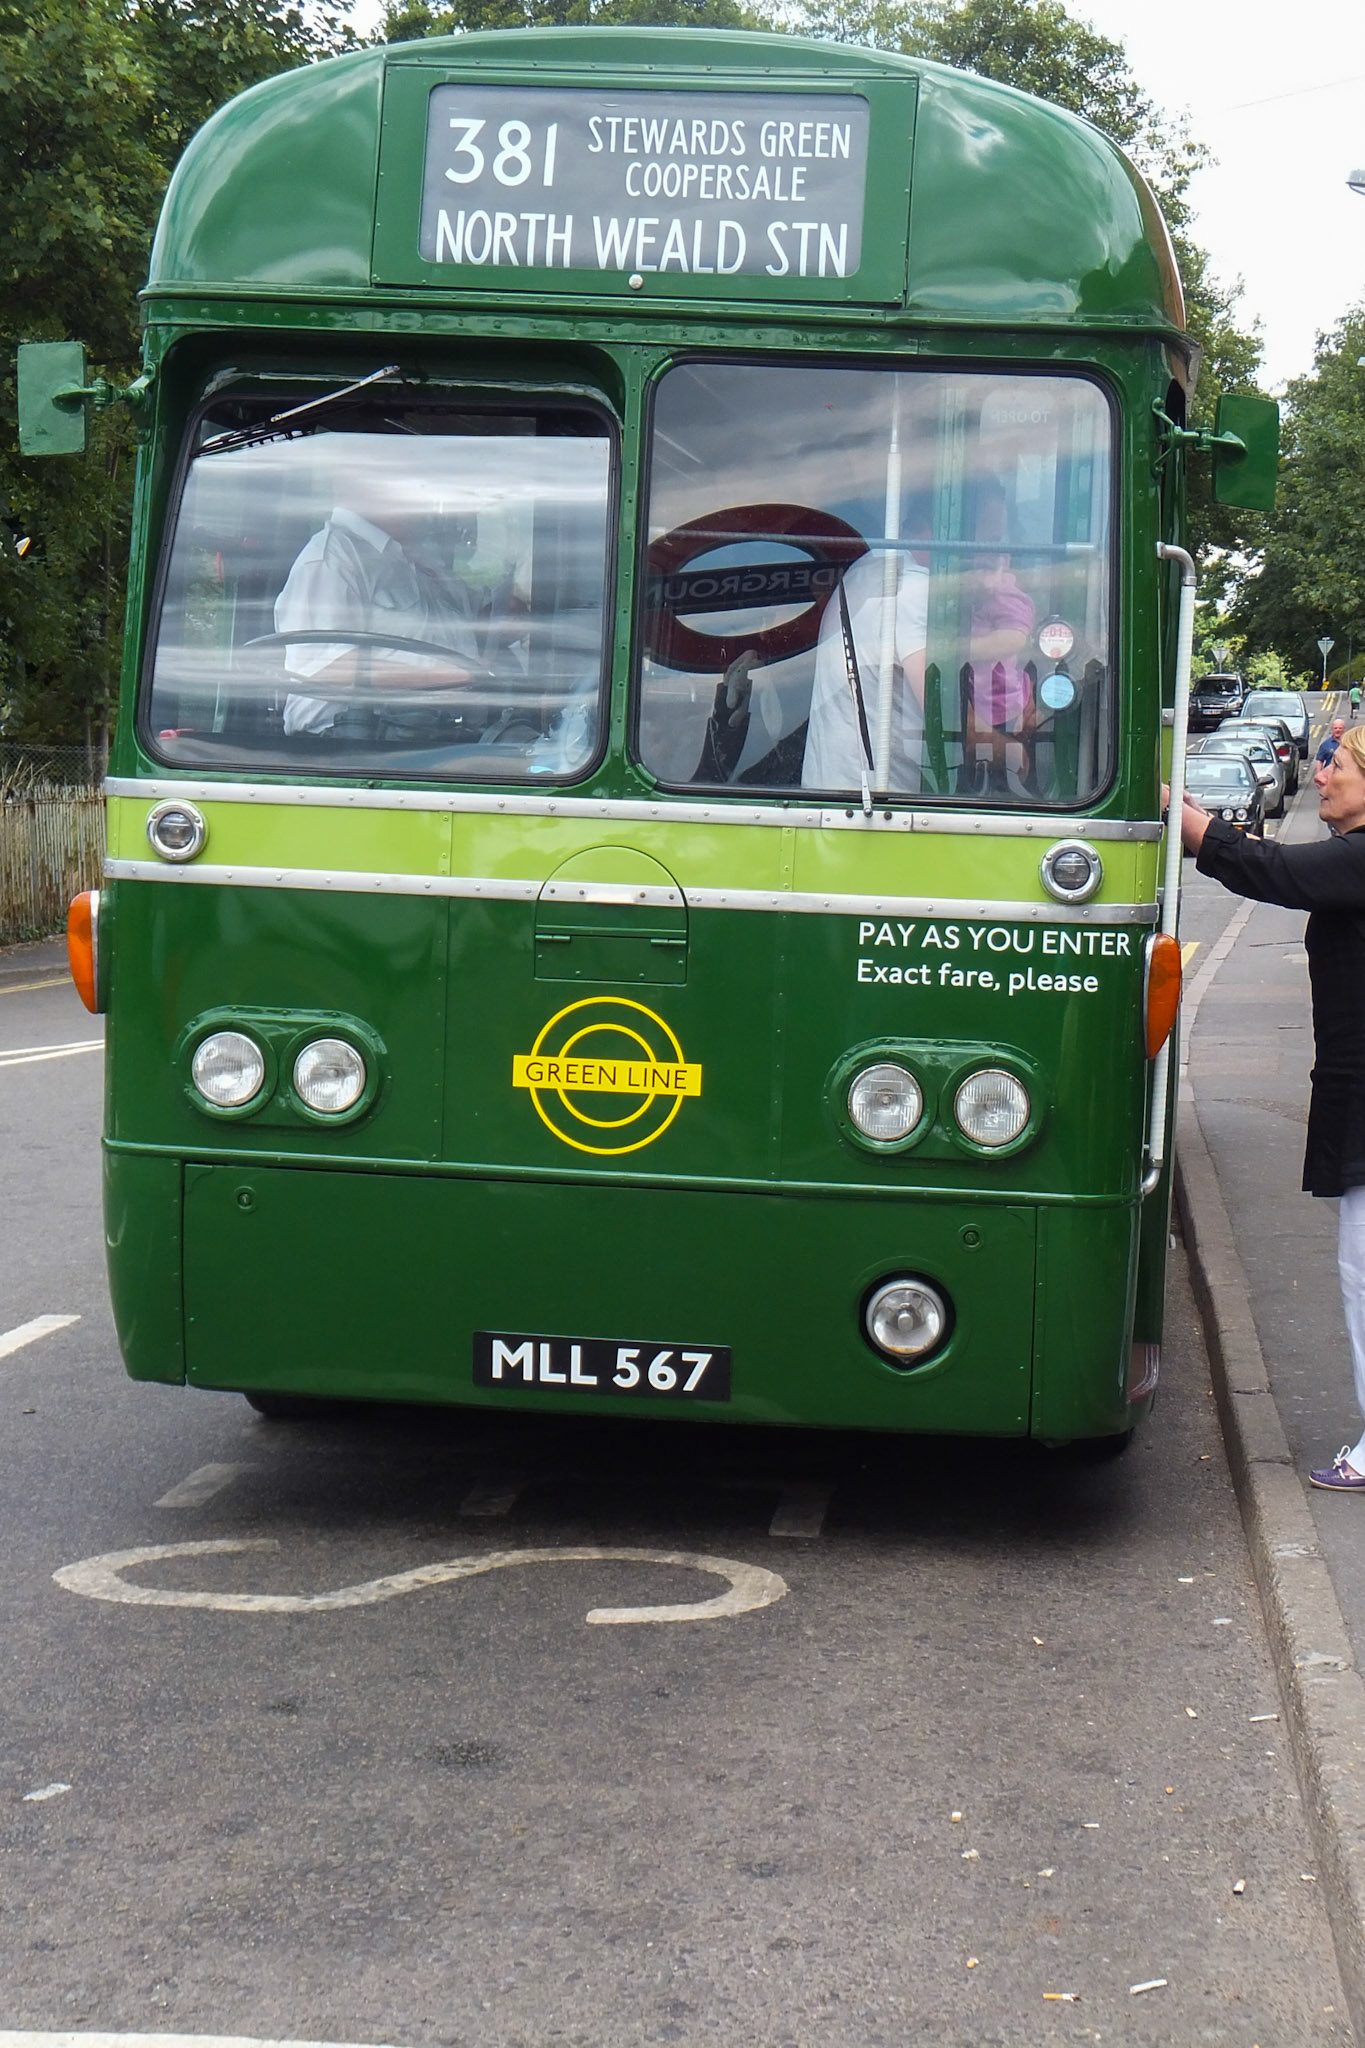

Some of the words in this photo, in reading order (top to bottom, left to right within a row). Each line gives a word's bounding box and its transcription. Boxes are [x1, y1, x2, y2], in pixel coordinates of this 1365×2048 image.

[445, 118, 557, 187] 381
[587, 116, 746, 155] STEWARDS
[759, 122, 850, 159] GREEN
[625, 163, 807, 201] COOPERSALE
[436, 209, 572, 267] NORTH
[592, 215, 746, 274] WEALD
[765, 222, 848, 278] STN
[858, 921, 916, 947] PAY
[920, 924, 960, 949] AS
[967, 927, 1035, 953] YOU
[1041, 930, 1131, 956] ENTER
[857, 958, 931, 985] Exact
[938, 963, 1001, 991] fare,
[1008, 967, 1099, 996] please
[525, 1061, 617, 1086] GREEN
[627, 1066, 688, 1090] LINE
[491, 1339, 598, 1386] MLL
[612, 1347, 713, 1392] 567
